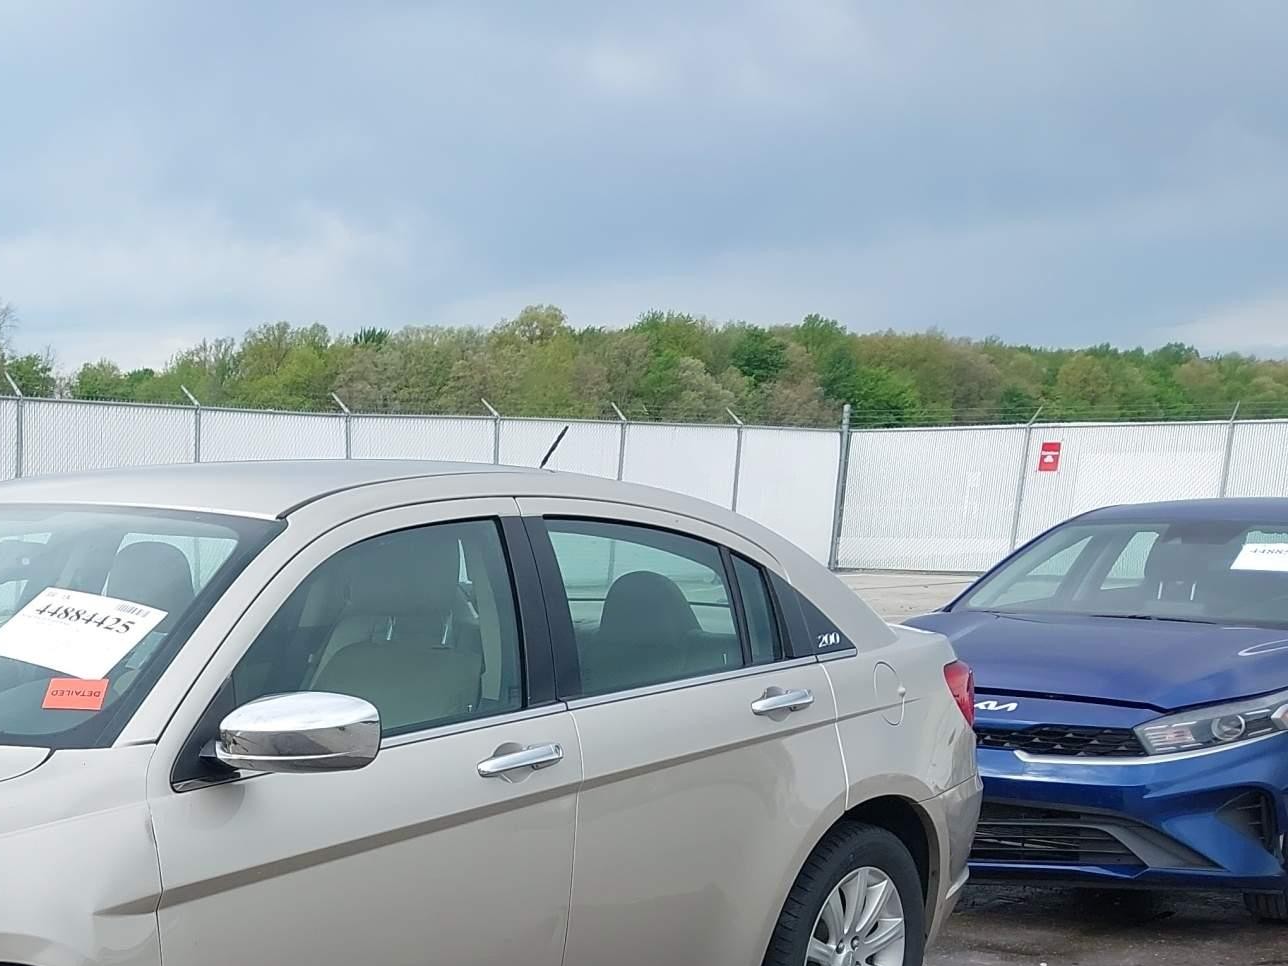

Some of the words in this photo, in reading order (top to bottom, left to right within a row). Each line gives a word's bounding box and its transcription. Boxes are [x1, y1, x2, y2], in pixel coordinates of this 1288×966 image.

[35, 603, 136, 635] 44884425
[817, 632, 840, 648] 200
[50, 689, 102, 698] DETAILED
